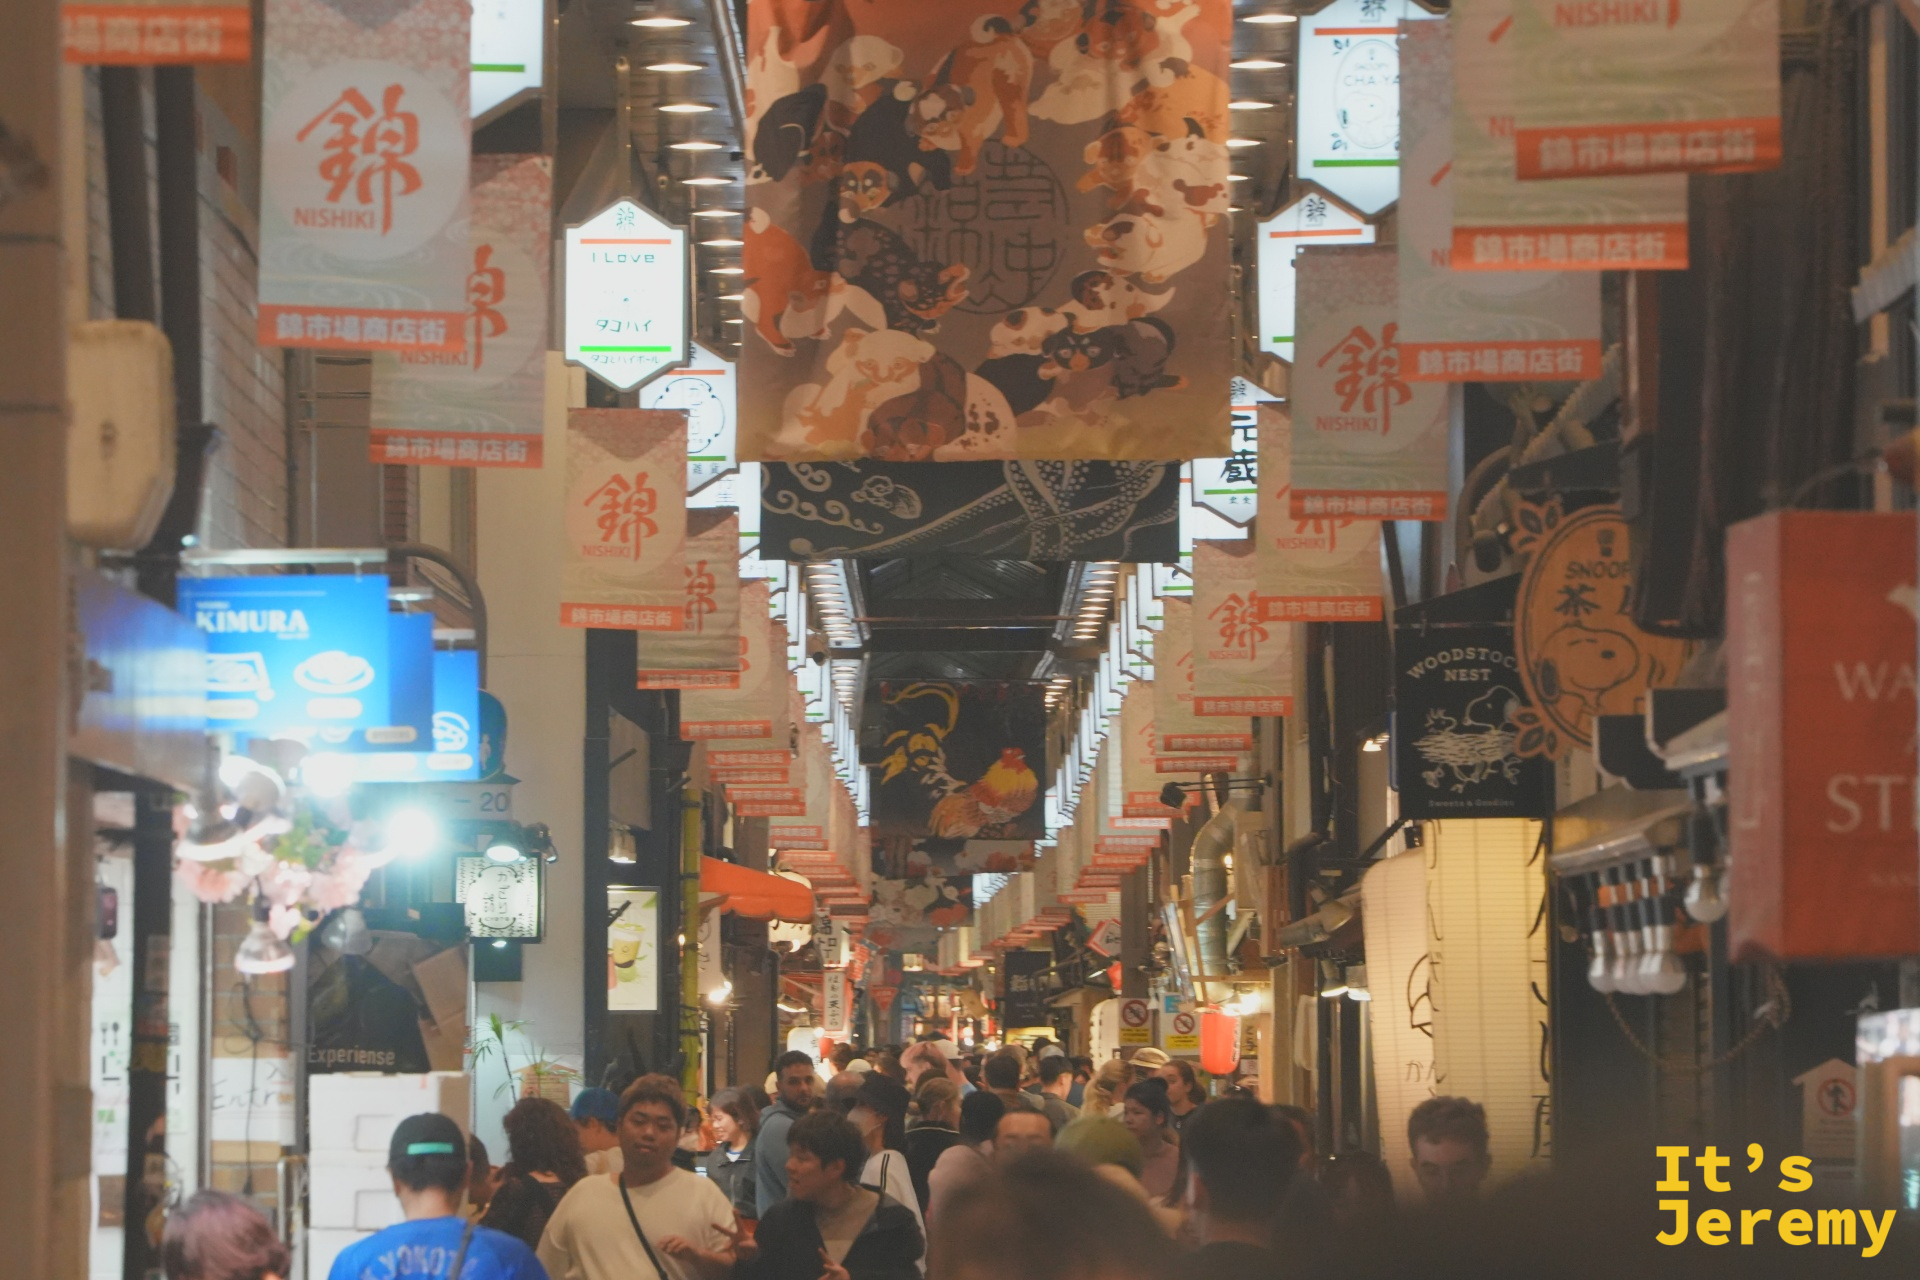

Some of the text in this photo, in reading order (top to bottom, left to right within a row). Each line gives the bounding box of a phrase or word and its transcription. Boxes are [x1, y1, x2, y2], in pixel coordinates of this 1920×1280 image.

[1555, 1, 1658, 26] NISHIKI
[296, 84, 423, 236] 錦
[293, 207, 376, 230] NISHIKI
[604, 252, 655, 263] Love
[1473, 232, 1666, 264] 錦市場商店街
[275, 313, 446, 345] 錦市場商店街
[596, 319, 652, 333] タコハイ
[1417, 347, 1583, 375] 錦市場商店街
[1315, 416, 1377, 432] NISHIKI
[385, 436, 529, 463] 錦市場商店街
[584, 471, 658, 562] 錦
[1304, 495, 1433, 516] 錦市場商店街
[582, 544, 630, 558] NISHIKI
[1277, 537, 1326, 550] NISHIKI
[196, 608, 310, 633] KIMURA
[571, 607, 672, 627] 錦市場商店街
[1406, 647, 1519, 679] WOODSTOC
[1444, 668, 1492, 682] NEST
